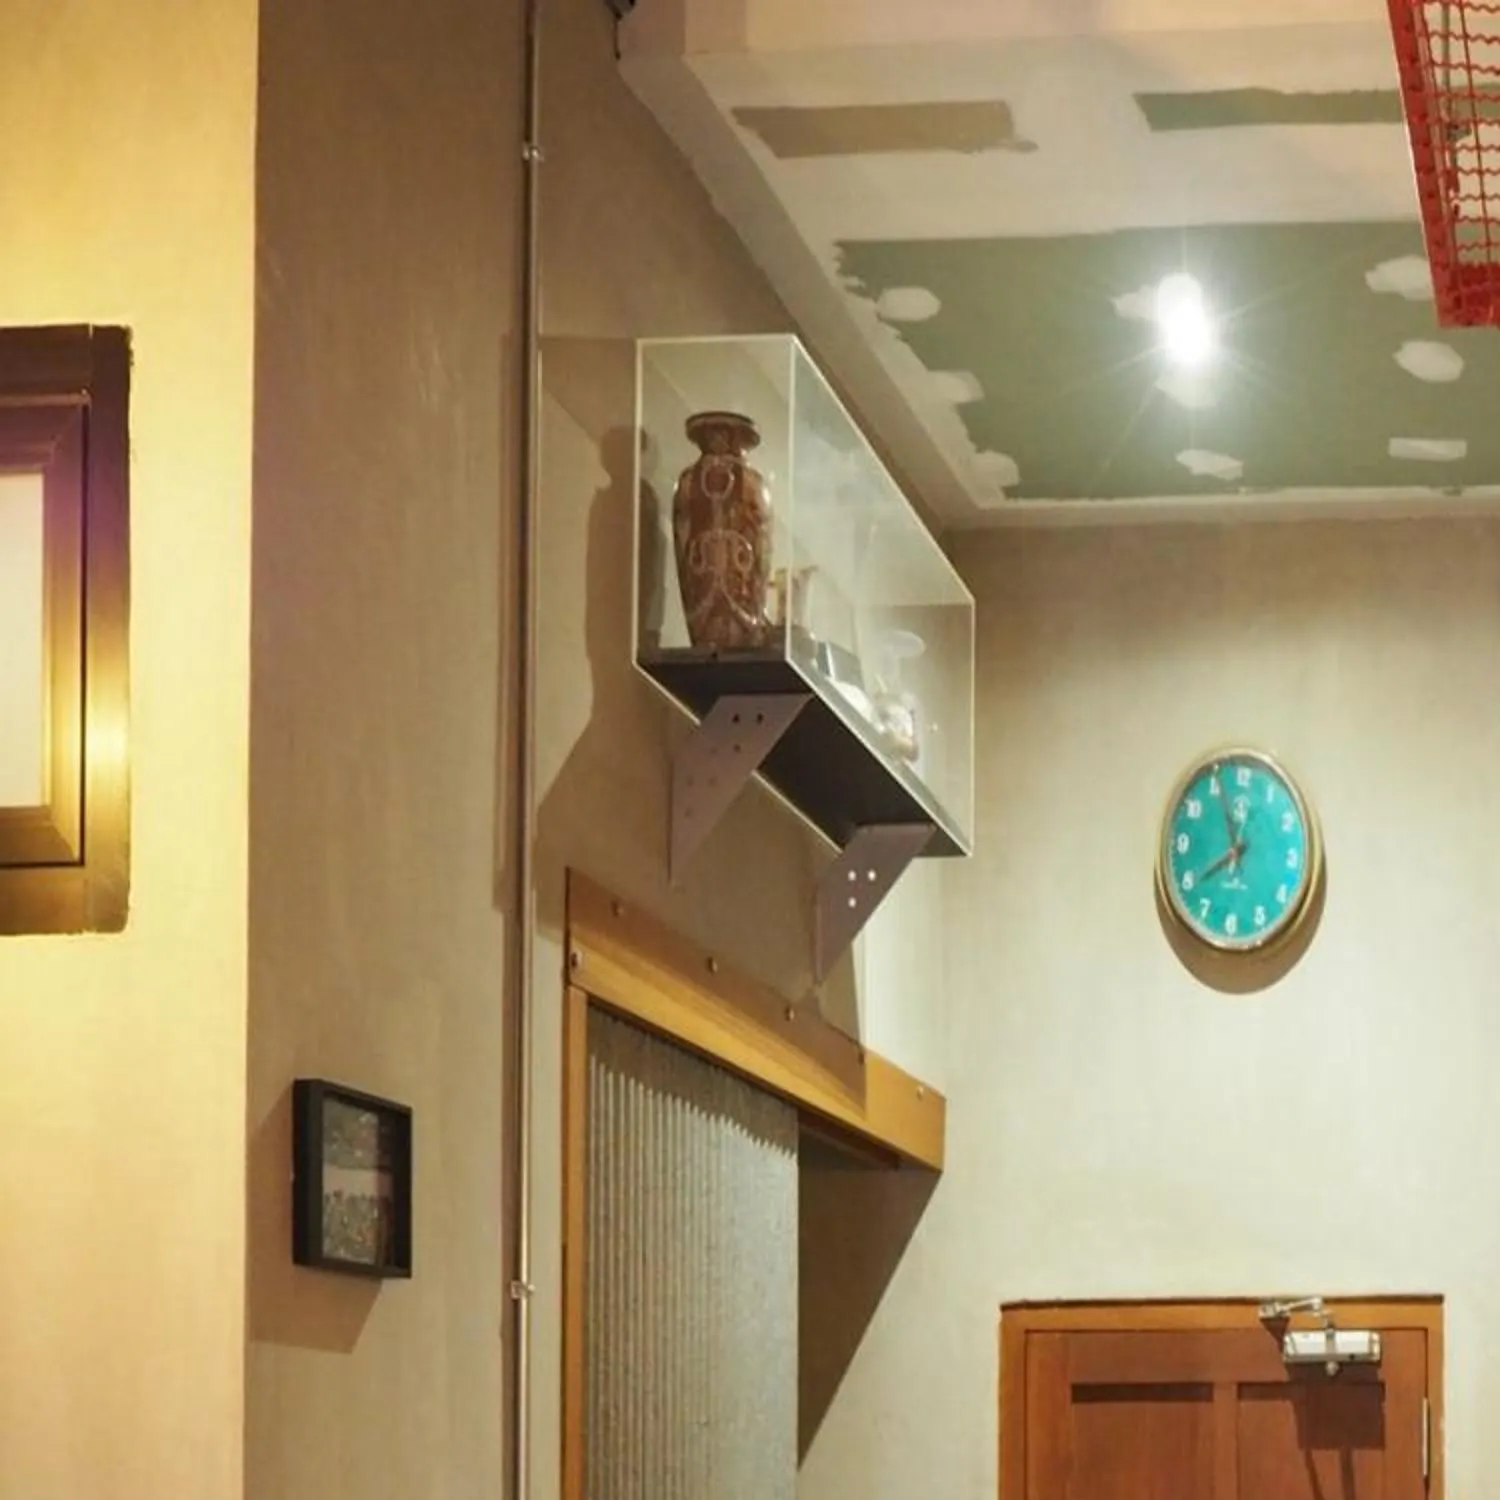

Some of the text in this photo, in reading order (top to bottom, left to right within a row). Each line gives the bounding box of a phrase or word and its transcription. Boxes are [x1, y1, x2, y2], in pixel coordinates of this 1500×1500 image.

[1237, 767, 1251, 787] 12
[1266, 783, 1275, 804] 1
[1185, 799, 1202, 818] 10
[1281, 812, 1294, 832] 2
[1177, 832, 1189, 853] 9
[1286, 848, 1298, 868] 3
[1182, 870, 1194, 891] 8
[1276, 883, 1287, 904] 4
[1200, 897, 1211, 919] 7
[1255, 904, 1265, 926] 5
[1225, 913, 1237, 936] 6
